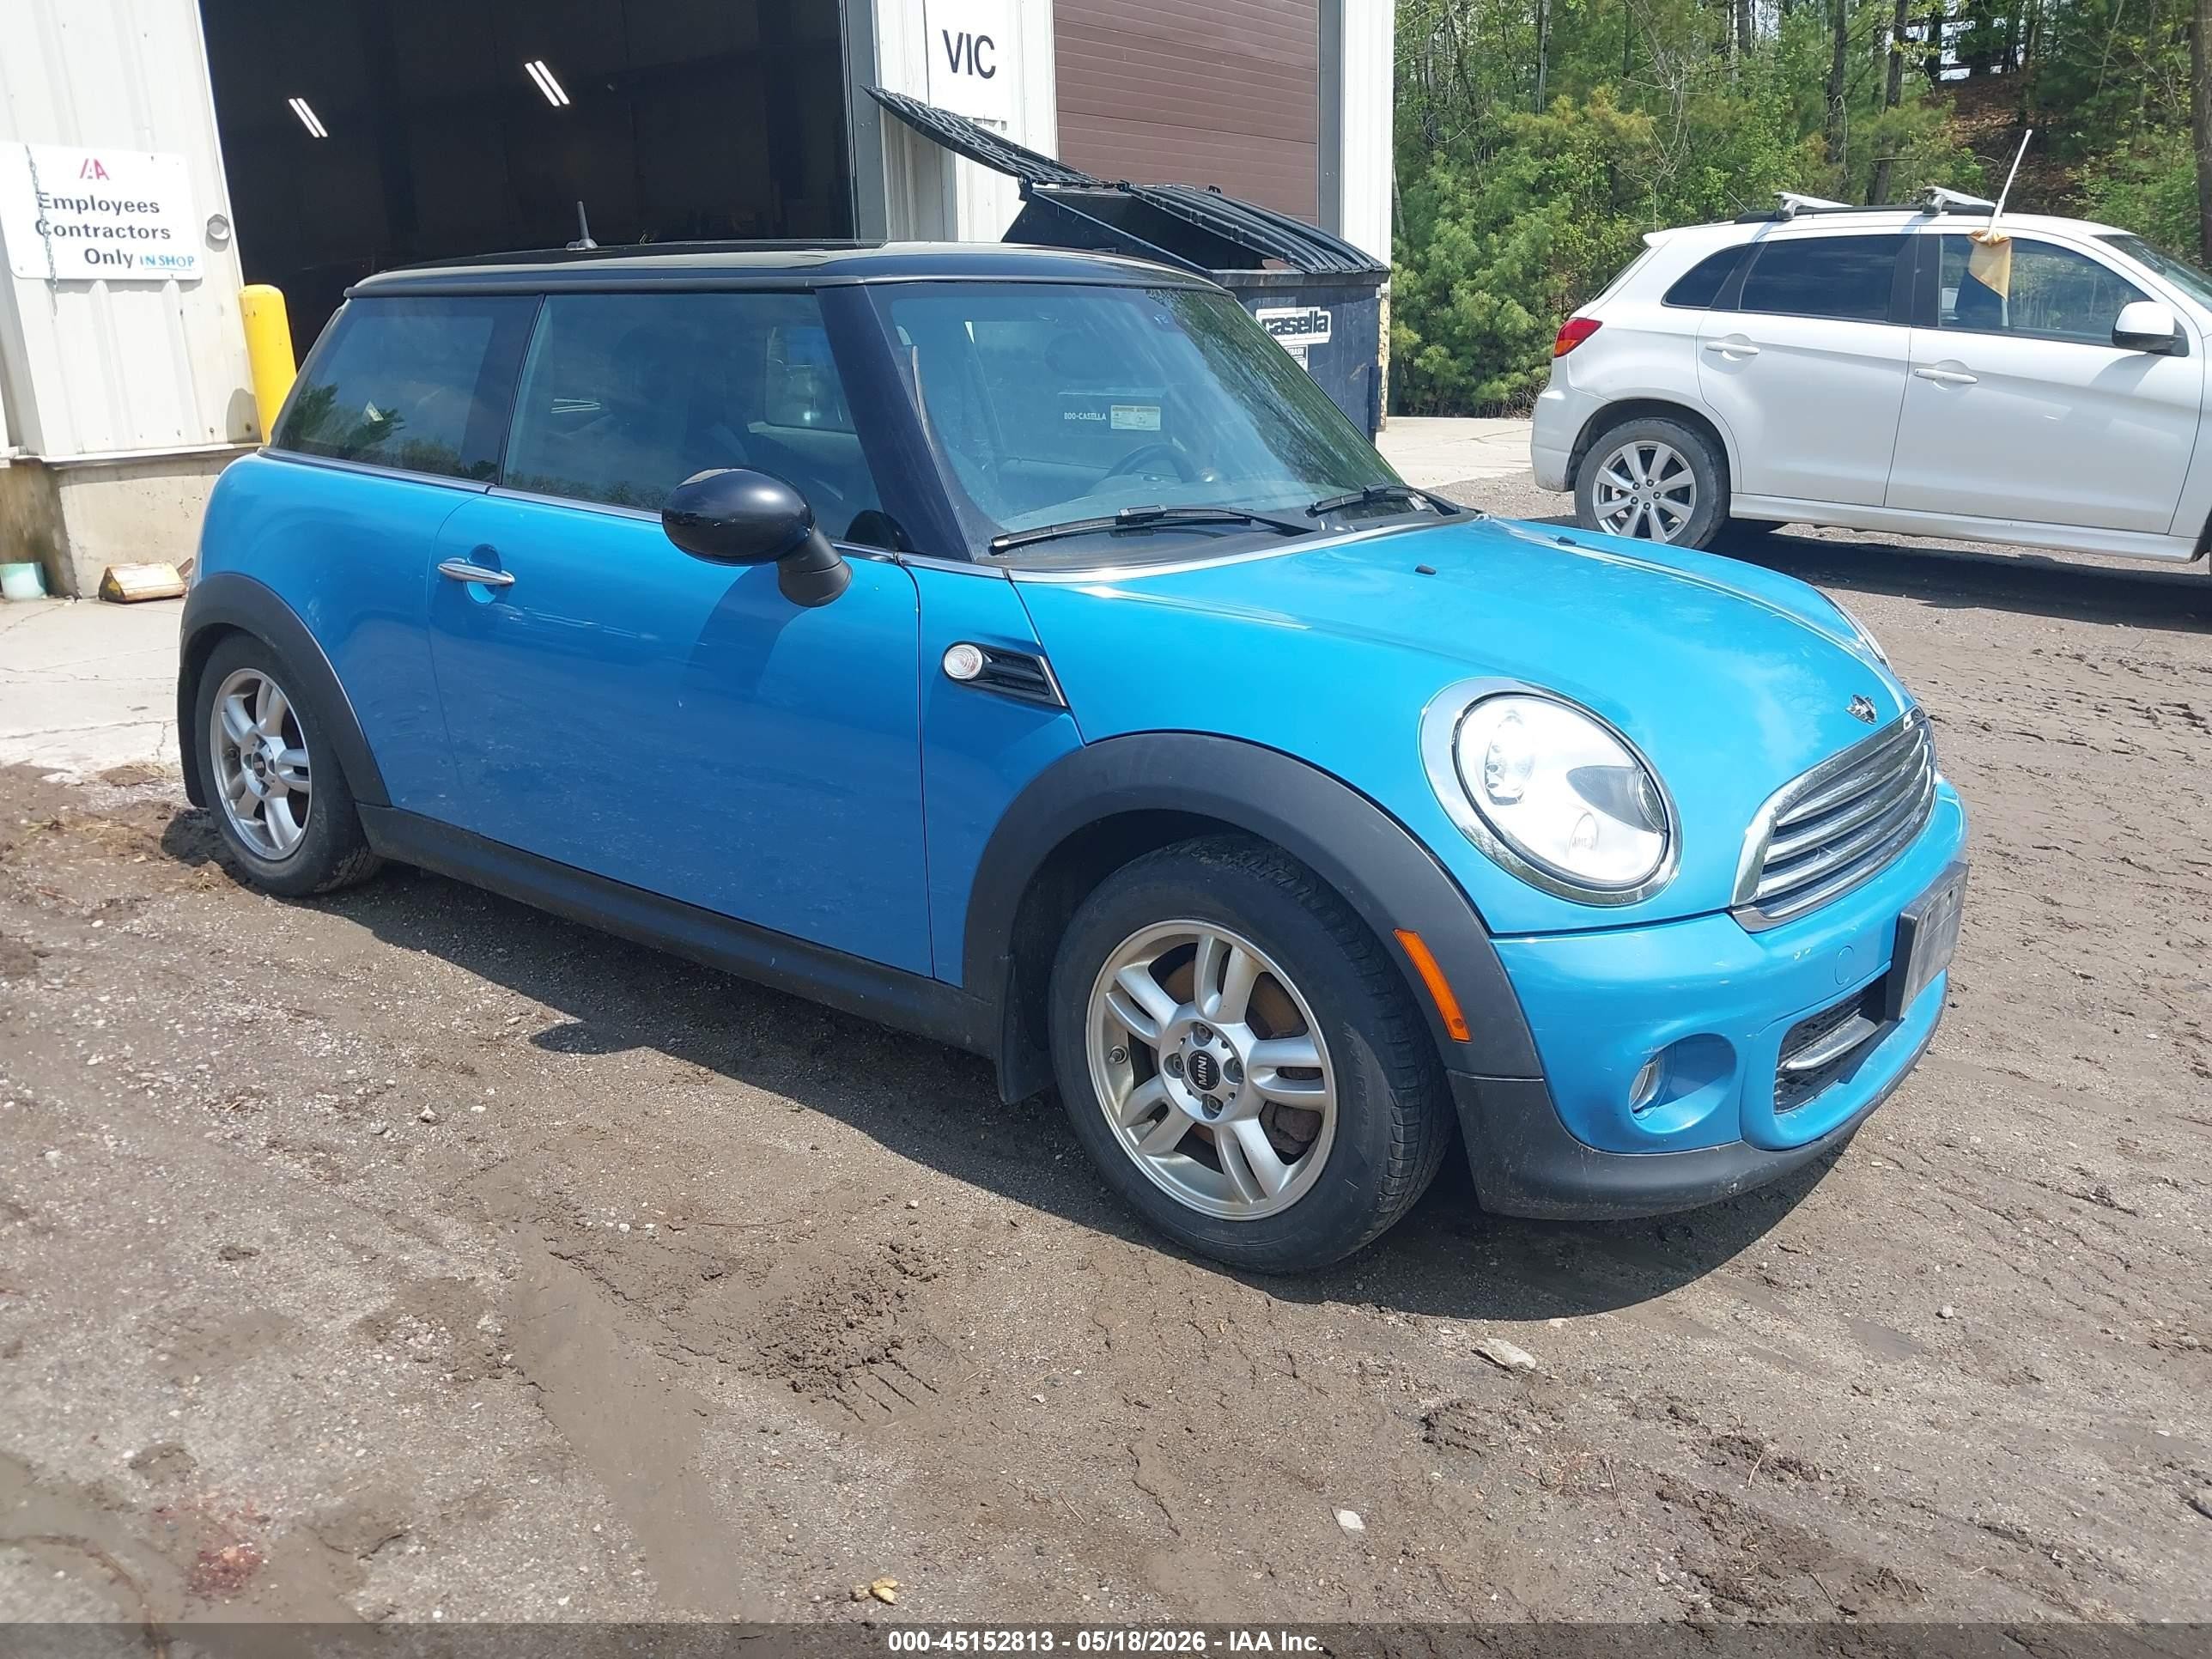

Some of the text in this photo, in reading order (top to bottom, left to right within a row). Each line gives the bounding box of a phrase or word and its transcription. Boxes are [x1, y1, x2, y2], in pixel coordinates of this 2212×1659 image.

[941, 29, 996, 79] VIC
[38, 191, 161, 216] Employees
[35, 219, 172, 240] Contractors
[83, 248, 134, 268] Only
[158, 255, 194, 268] SHOP
[1198, 1055, 1207, 1086] MINI
